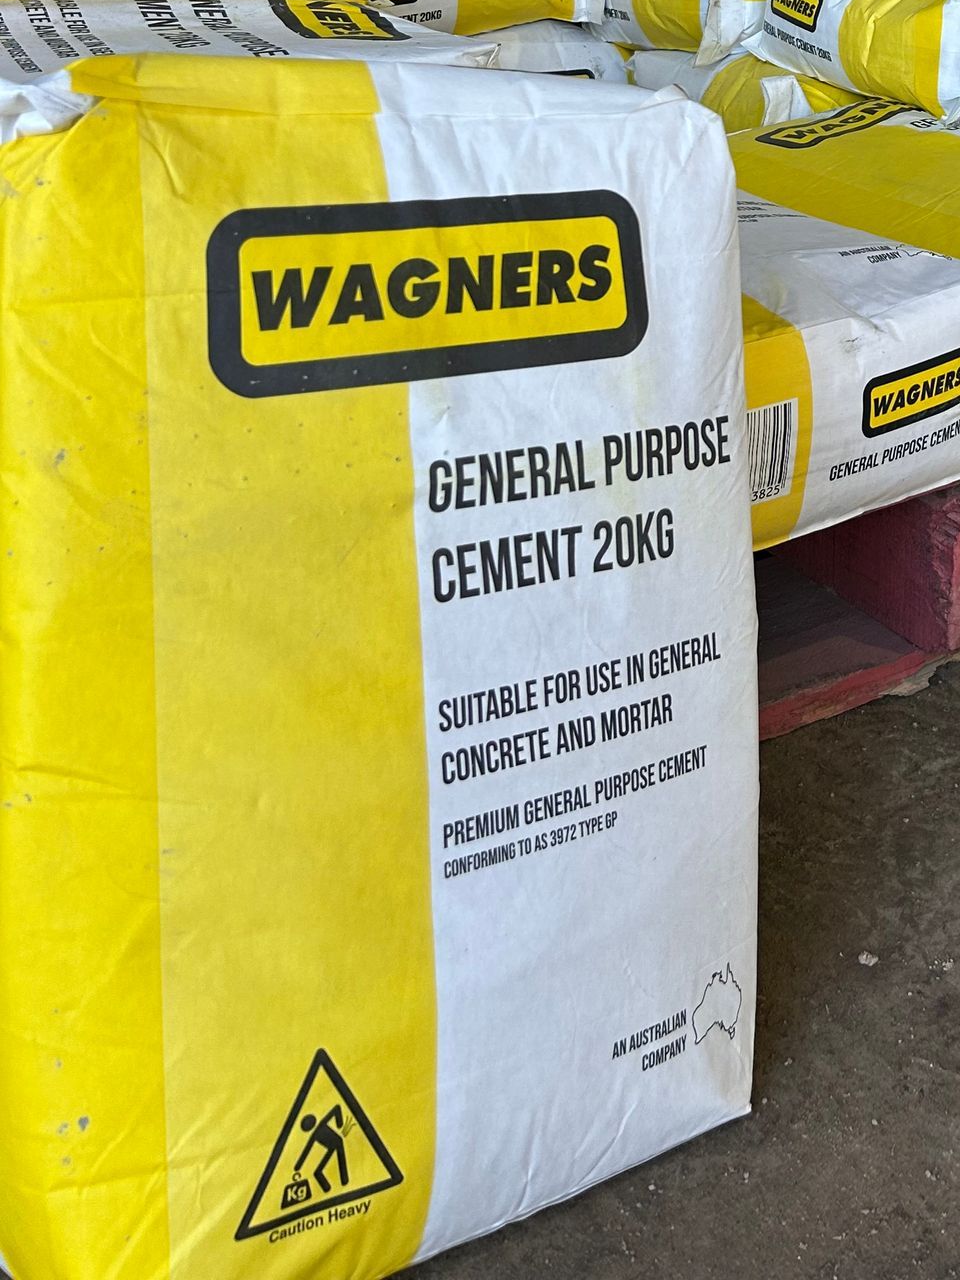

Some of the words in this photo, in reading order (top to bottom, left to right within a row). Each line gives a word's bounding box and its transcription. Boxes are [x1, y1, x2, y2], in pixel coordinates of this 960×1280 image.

[420, 10, 442, 22] 20KG
[777, 28, 796, 47] PURPOSE
[796, 38, 817, 56] CEMENT
[817, 47, 832, 62] 20KG
[867, 251, 902, 264] COMPANY
[250, 244, 613, 331] WAGNERS
[428, 440, 595, 514] GENERAL
[603, 415, 731, 488] PURPOSE
[829, 452, 879, 482] GENERAL
[881, 435, 929, 465] PURPOSE
[432, 525, 585, 605] CEMENT
[592, 509, 675, 572] 20KG
[438, 679, 539, 732] SUITABLE
[543, 670, 581, 707] FOR
[586, 658, 622, 697] USE
[626, 653, 645, 686] IN
[649, 631, 721, 680] GENERAL
[441, 727, 551, 785] CONCRETE
[556, 715, 596, 756] AND
[601, 693, 673, 742] MORTAR
[443, 804, 520, 848] PREMIUM
[523, 784, 591, 825] GENERAL
[595, 763, 656, 804] PURPOSE
[658, 744, 708, 783] CEMENT
[444, 842, 516, 879] CONFORMING
[518, 839, 532, 856] TO
[534, 834, 548, 852] AS
[550, 824, 577, 847] 3972
[579, 816, 604, 839] TYPE
[605, 811, 618, 829] GP
[612, 1038, 627, 1060] AN
[628, 1009, 687, 1053] AUSTRALIAN
[642, 1034, 687, 1071] COMPANY
[287, 1184, 307, 1202] Kg
[269, 1217, 324, 1243] Caution
[328, 1200, 371, 1223] Heavy
